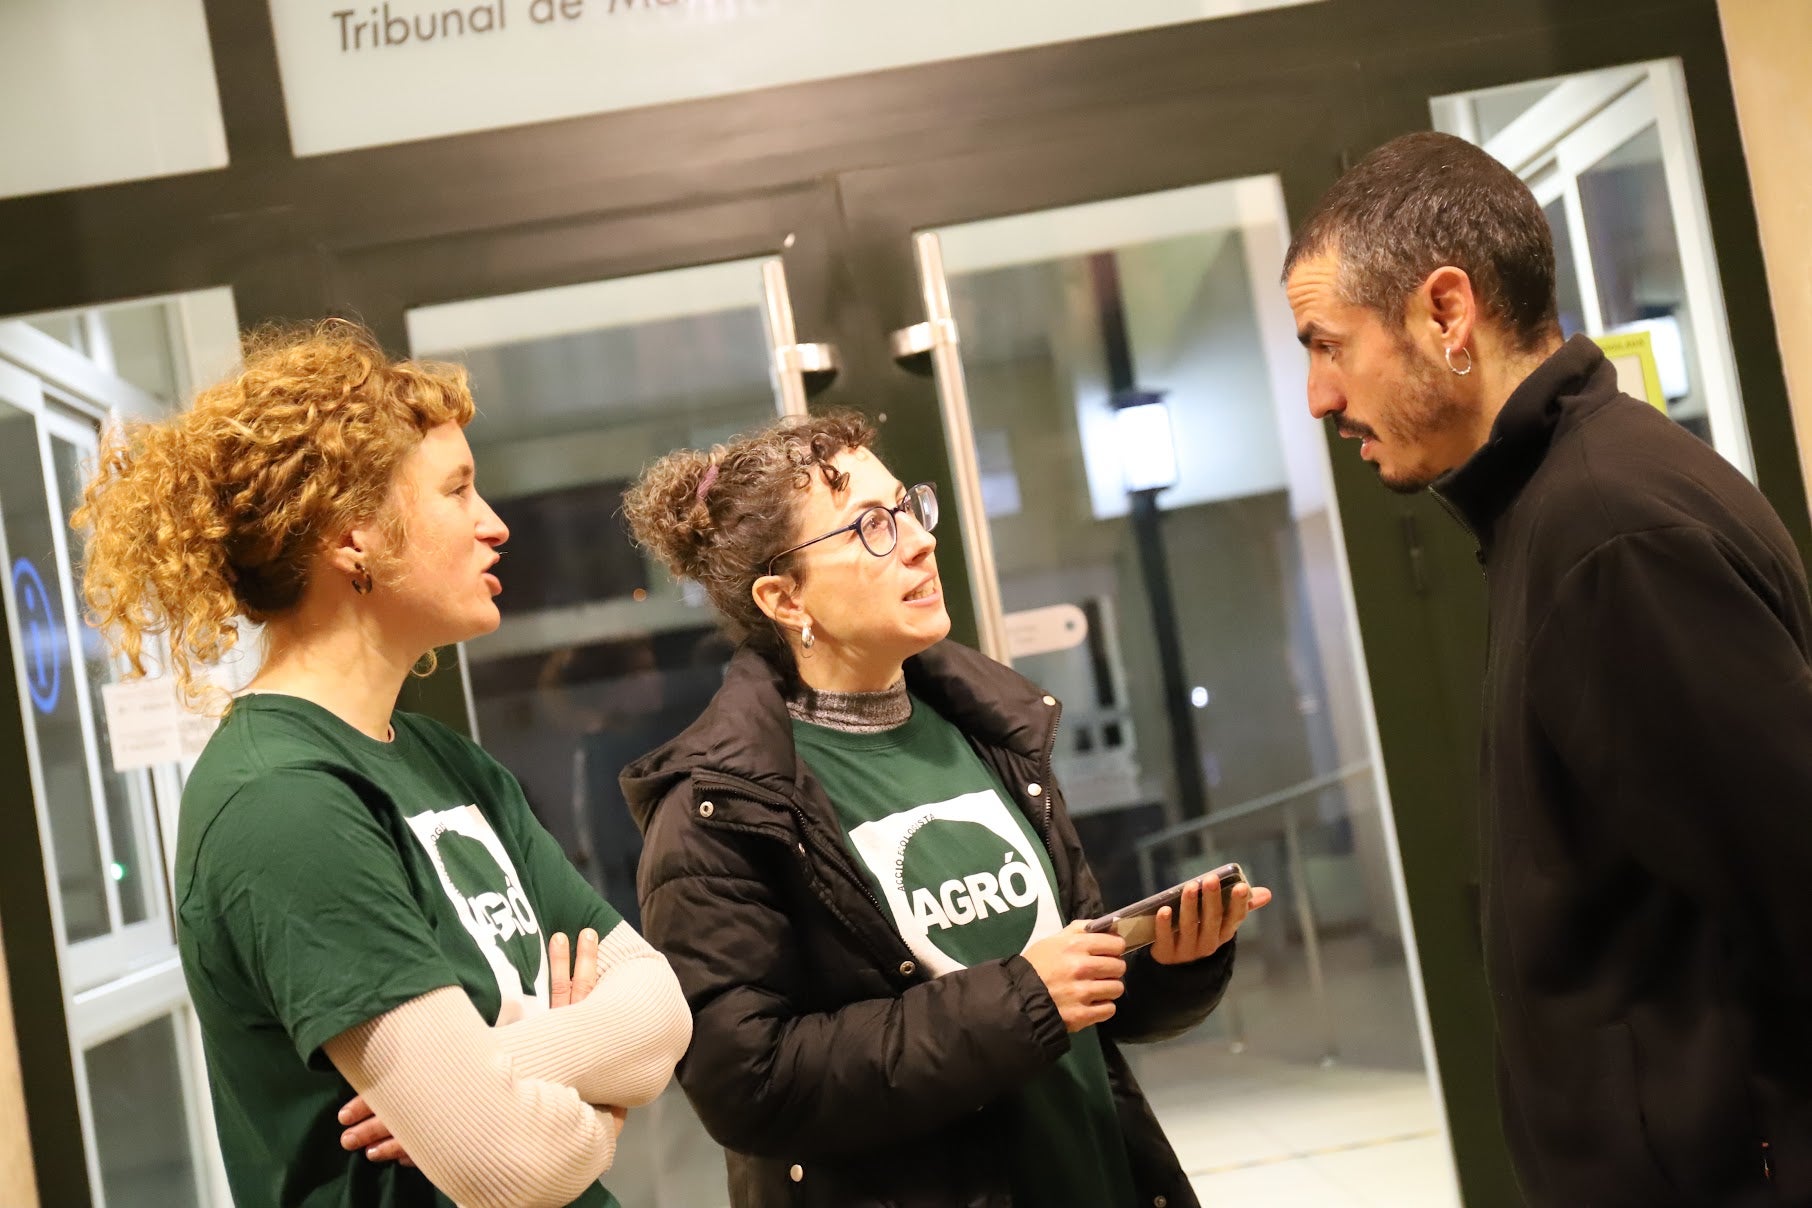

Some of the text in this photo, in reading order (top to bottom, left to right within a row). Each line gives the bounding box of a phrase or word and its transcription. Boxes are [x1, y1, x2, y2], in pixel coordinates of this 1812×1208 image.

[331, 0, 583, 53] Tribunal de
[911, 851, 1038, 935] AGRÓ
